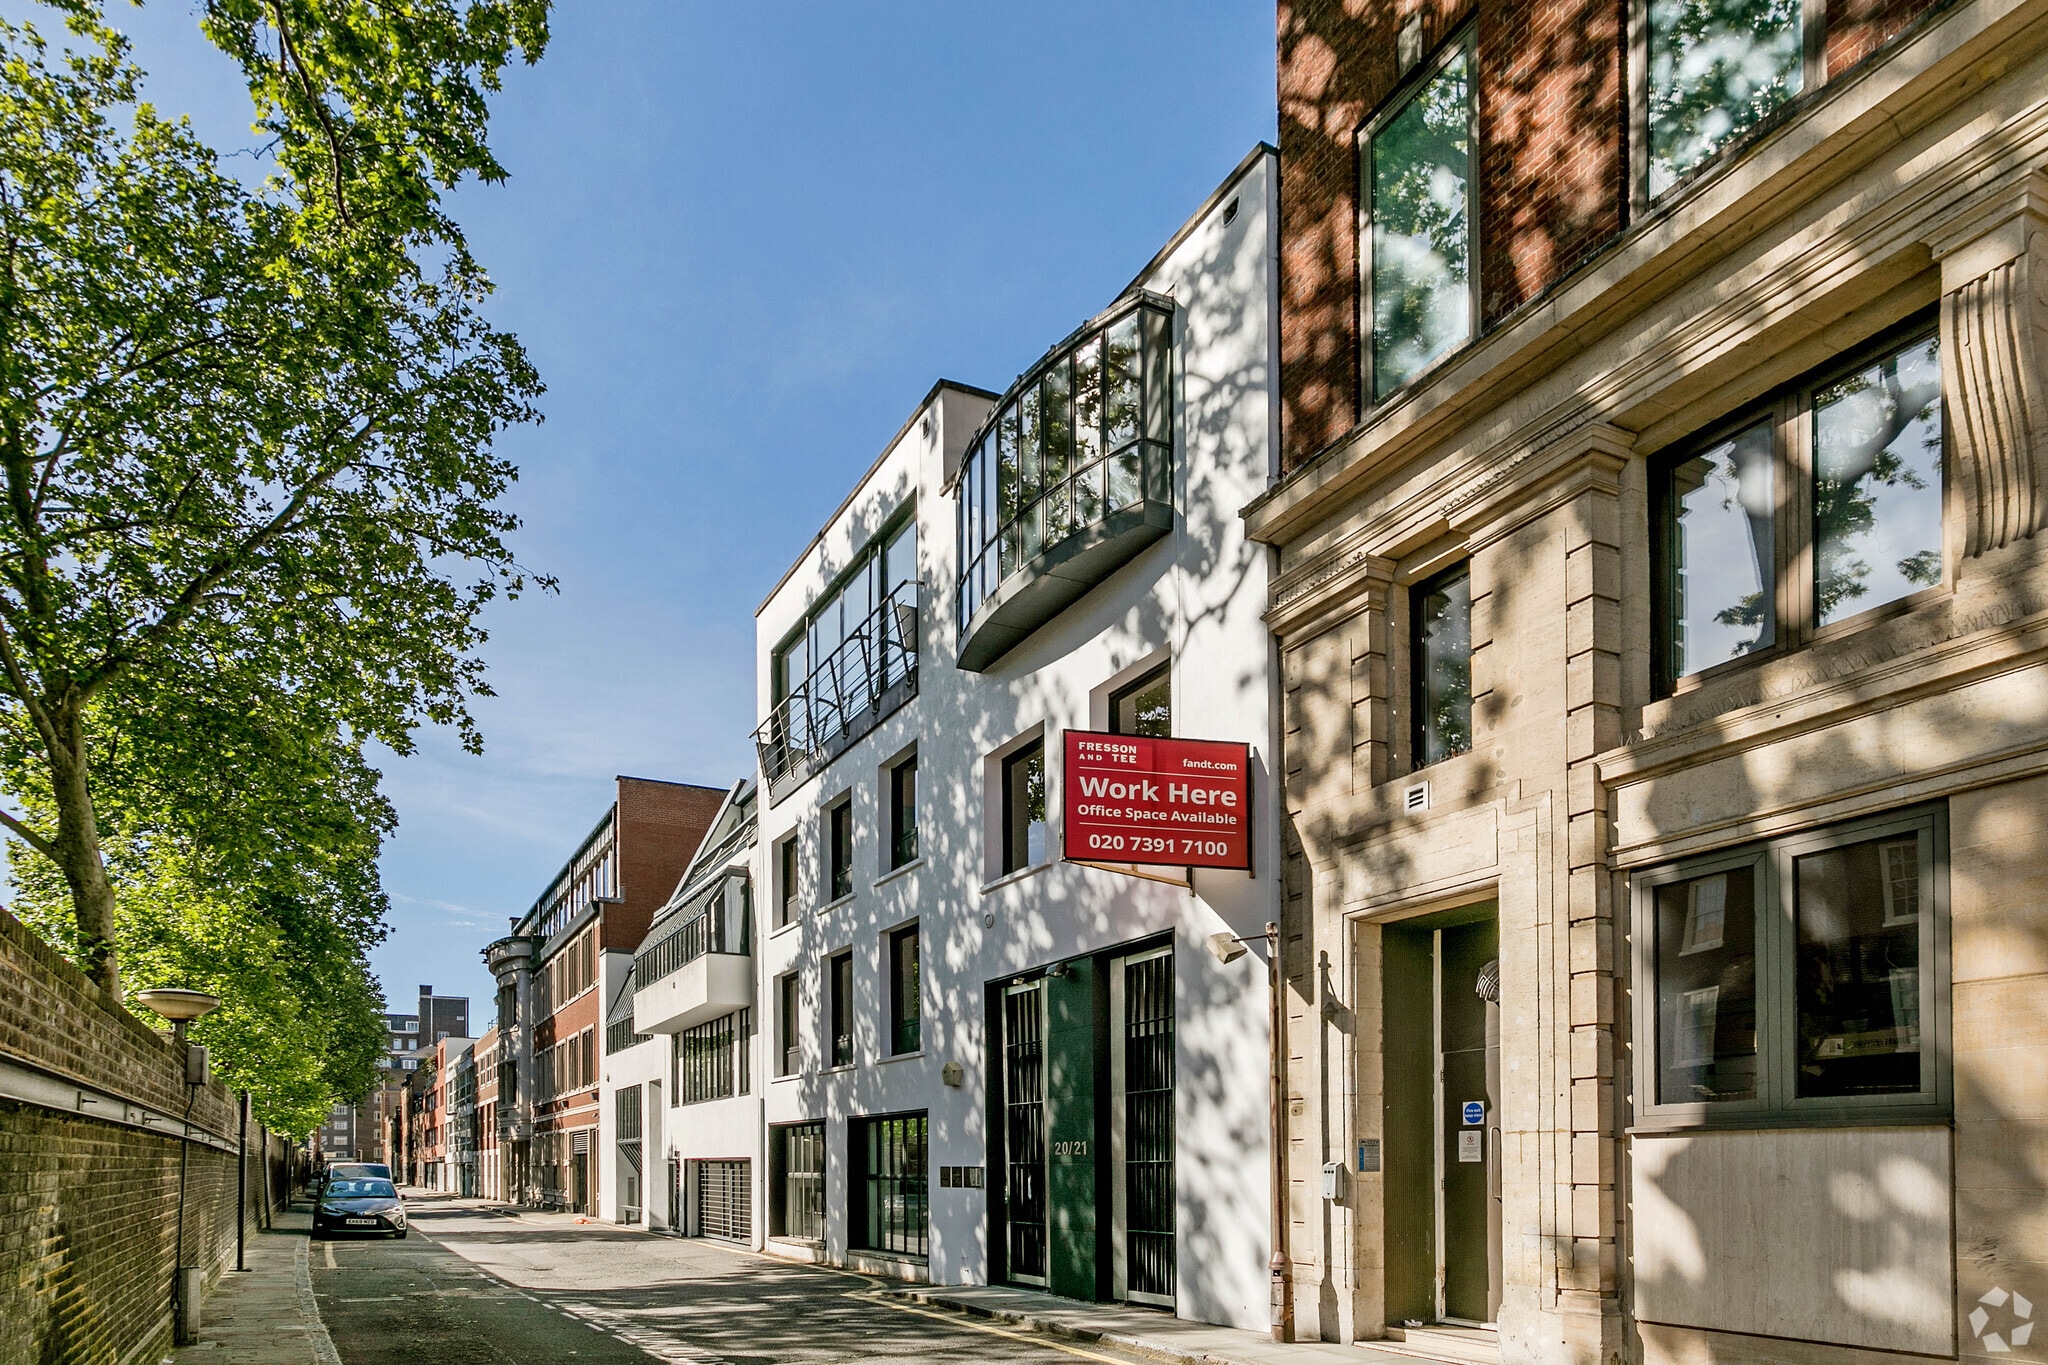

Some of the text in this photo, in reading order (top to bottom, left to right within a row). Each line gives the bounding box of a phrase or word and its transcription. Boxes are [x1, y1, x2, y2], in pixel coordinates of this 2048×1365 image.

[1078, 741, 1137, 754] FRESSON
[1079, 753, 1137, 763] AND TEE
[1183, 758, 1237, 771] fandt.com
[1079, 776, 1237, 807] Work Here
[1077, 804, 1237, 825] Office Space Available
[1089, 834, 1228, 856] 020 7391 7100
[1054, 1140, 1087, 1156] 20/21
